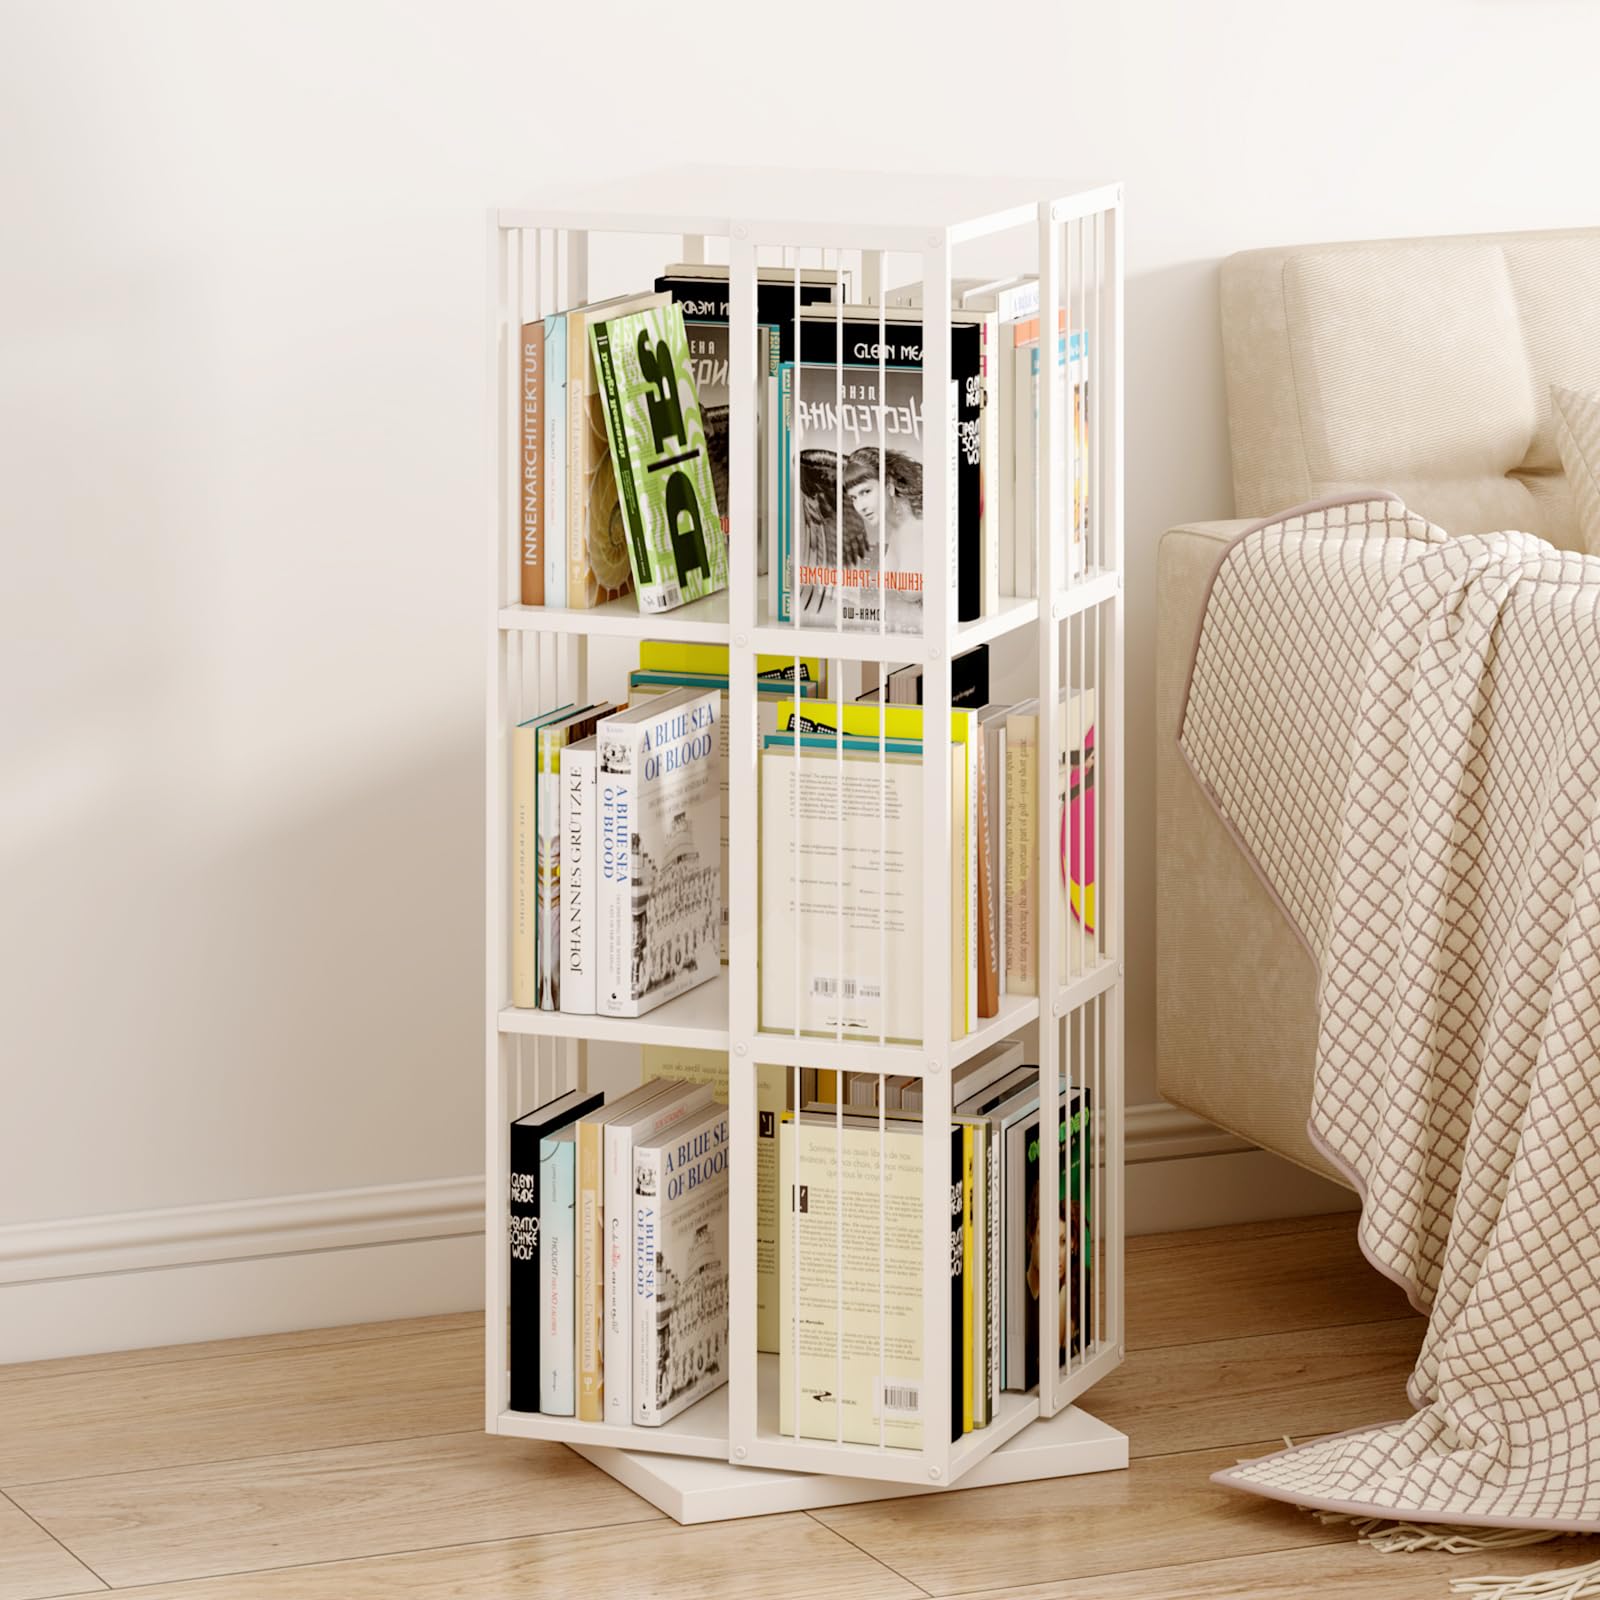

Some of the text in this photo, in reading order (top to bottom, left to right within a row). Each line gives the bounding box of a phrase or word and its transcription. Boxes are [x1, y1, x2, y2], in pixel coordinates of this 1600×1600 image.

[853, 343, 896, 359] GLEN
[524, 343, 538, 566] INNENARCHITEKTUR
[641, 703, 715, 754] A BLUE SEA
[644, 733, 712, 782] OF BLOOD
[616, 785, 628, 798] A
[603, 788, 614, 879] OF BLOOD
[616, 803, 628, 849] BLUE
[569, 766, 583, 975] JOHANNES GRÜTZKE
[616, 851, 628, 883] SEA
[664, 1119, 729, 1177] A BLUE SE
[667, 1172, 687, 1201] OF
[511, 1243, 533, 1260] WOLF
[551, 1236, 559, 1277] THOUGHT
[637, 1209, 645, 1295] OF BLOOD
[645, 1207, 654, 1299] A BLUE SEA
